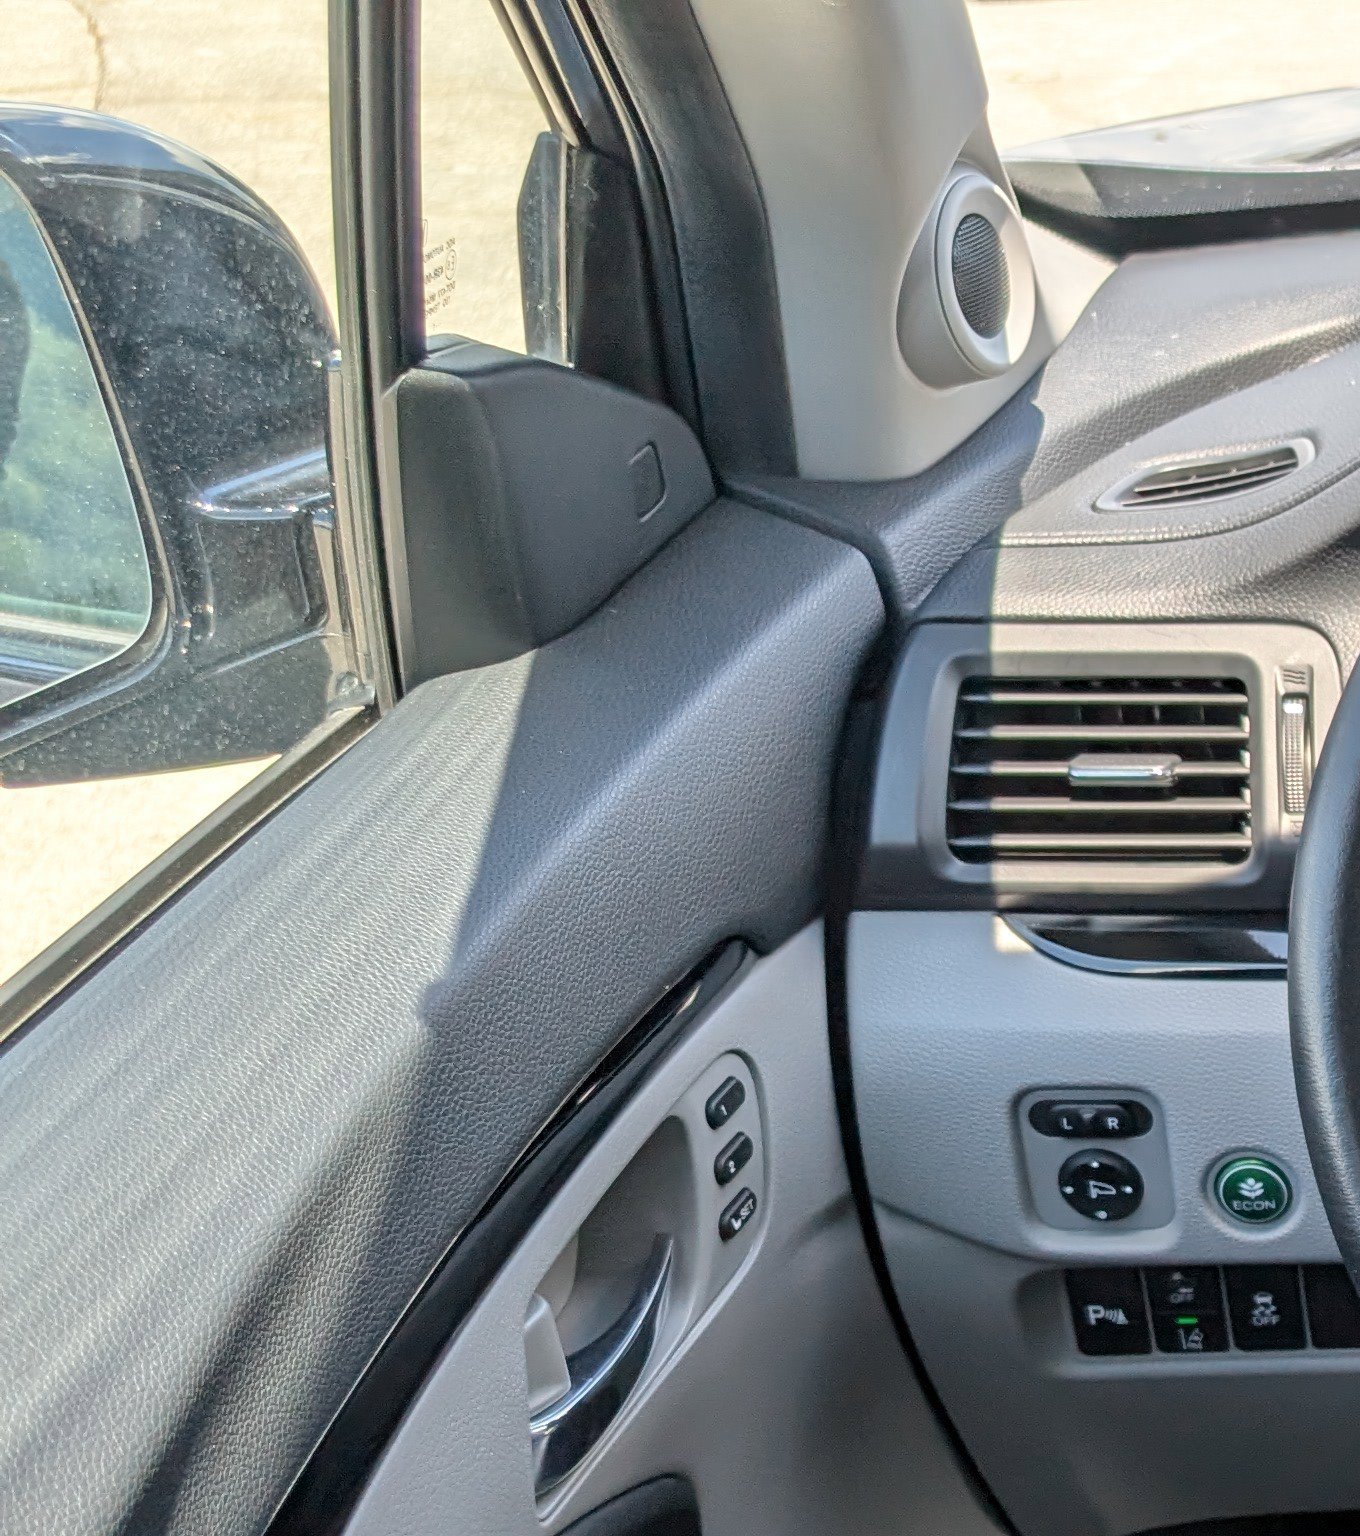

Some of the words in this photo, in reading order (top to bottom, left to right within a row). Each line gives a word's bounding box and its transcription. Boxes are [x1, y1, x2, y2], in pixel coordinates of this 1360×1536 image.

[720, 1105, 728, 1116] 1
[1062, 1118, 1073, 1130] L
[1107, 1117, 1119, 1129] R
[728, 1160, 736, 1173] 2
[1232, 1200, 1276, 1211] ECON
